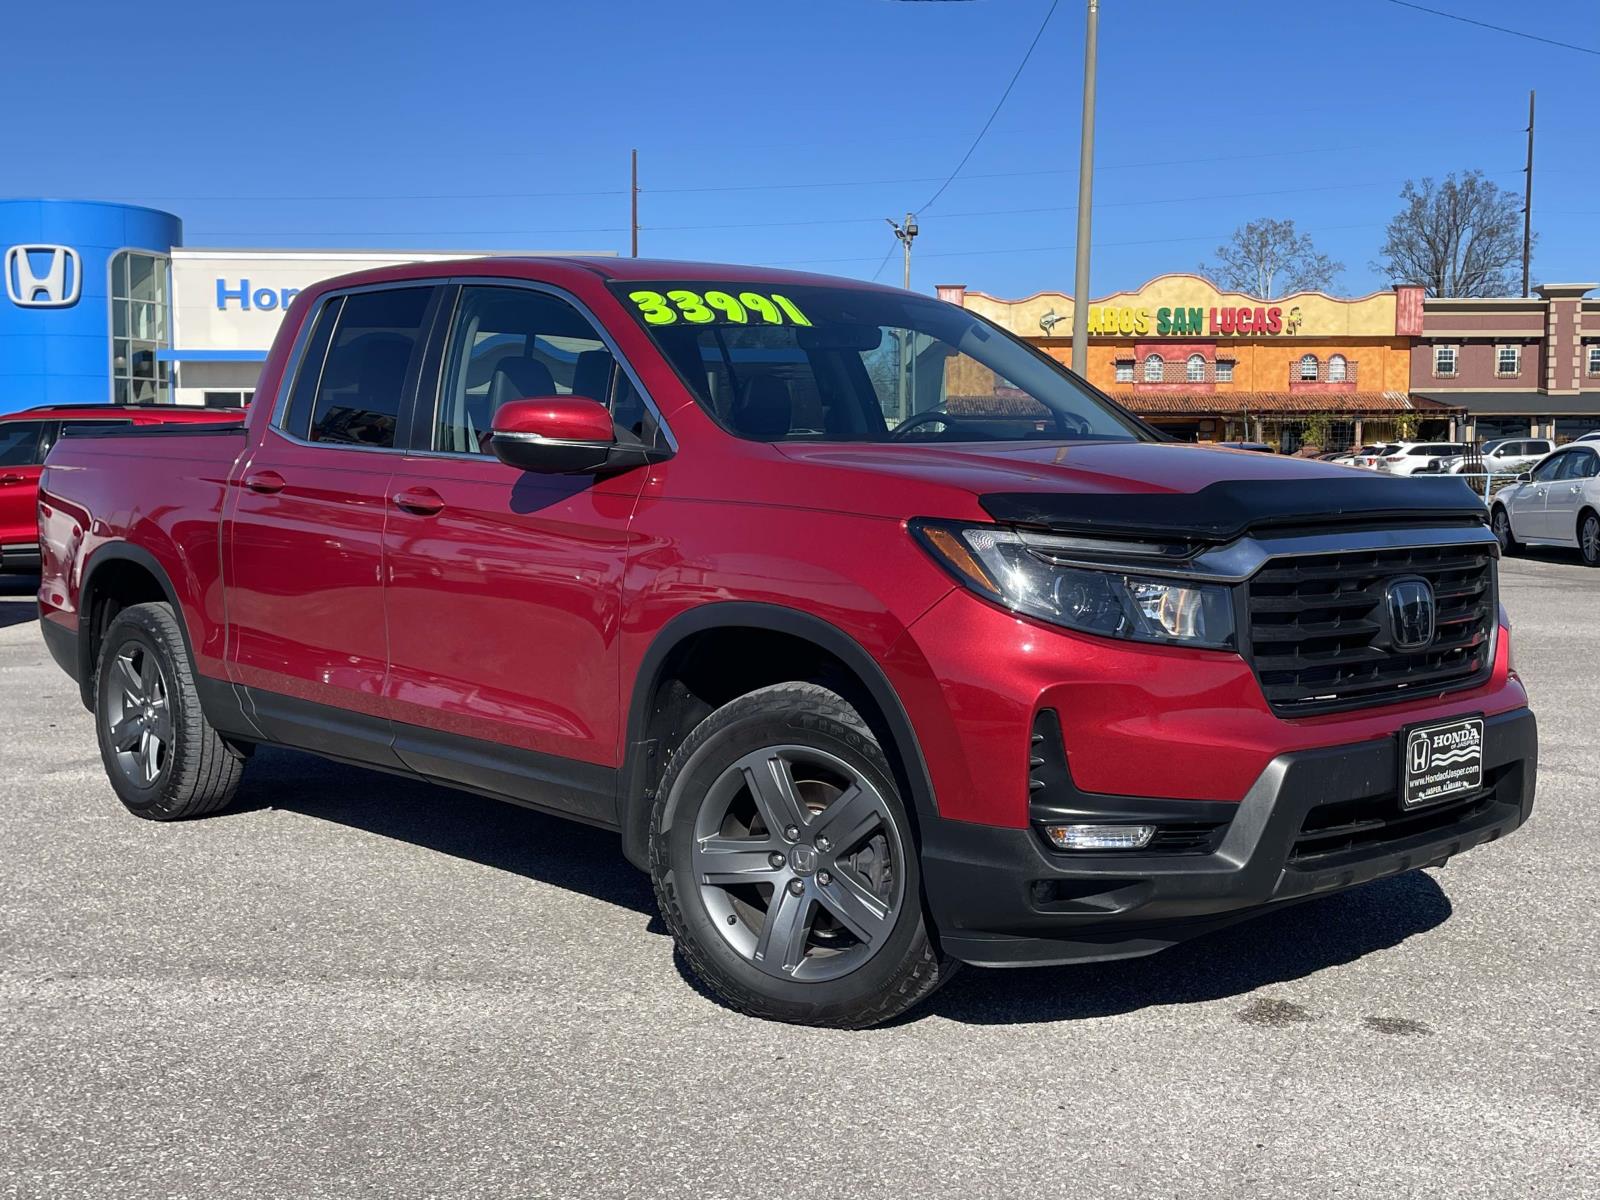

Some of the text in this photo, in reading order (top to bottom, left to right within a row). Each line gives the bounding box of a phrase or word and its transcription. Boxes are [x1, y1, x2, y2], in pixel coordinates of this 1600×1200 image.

[628, 290, 813, 327] 33991
[1087, 307, 1283, 336] ABOS SAN LUCAS
[1433, 728, 1479, 747] HONDA
